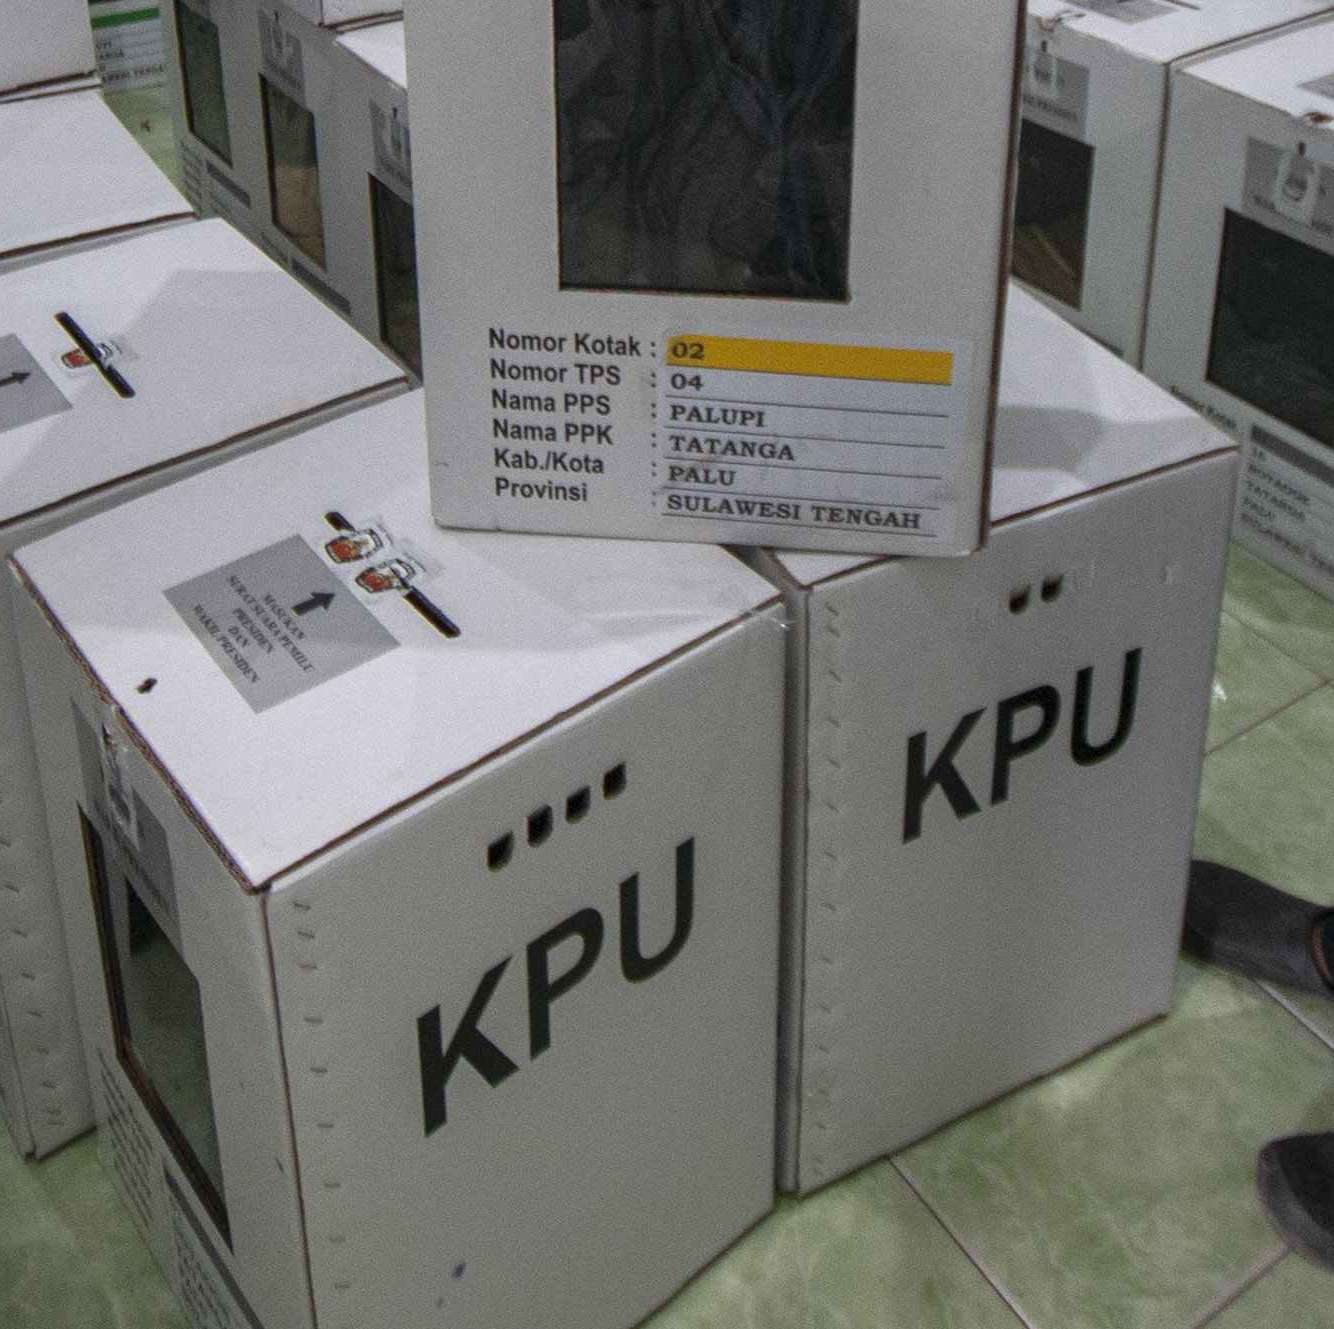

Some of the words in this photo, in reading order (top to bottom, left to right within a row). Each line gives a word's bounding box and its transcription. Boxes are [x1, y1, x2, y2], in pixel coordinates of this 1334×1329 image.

[488, 327, 566, 354] Nomor
[573, 332, 641, 358] Kotak
[670, 341, 705, 361] 02
[489, 357, 567, 384] Nomor
[573, 364, 622, 386] TPS
[670, 373, 704, 392] 04
[491, 388, 556, 414] Nama
[564, 393, 611, 416] PPS
[670, 404, 766, 428] PALUPI
[492, 418, 557, 444] Nama
[564, 422, 615, 446] PPK
[670, 435, 795, 462] TATANGA
[493, 448, 605, 475] Kab./Kota
[668, 465, 736, 488] PALU
[494, 477, 588, 503] Provinsi
[666, 493, 801, 521] SULAWESI
[810, 503, 923, 530] TENGAH
[903, 647, 1143, 843] KPU
[416, 837, 695, 1138] KPU
